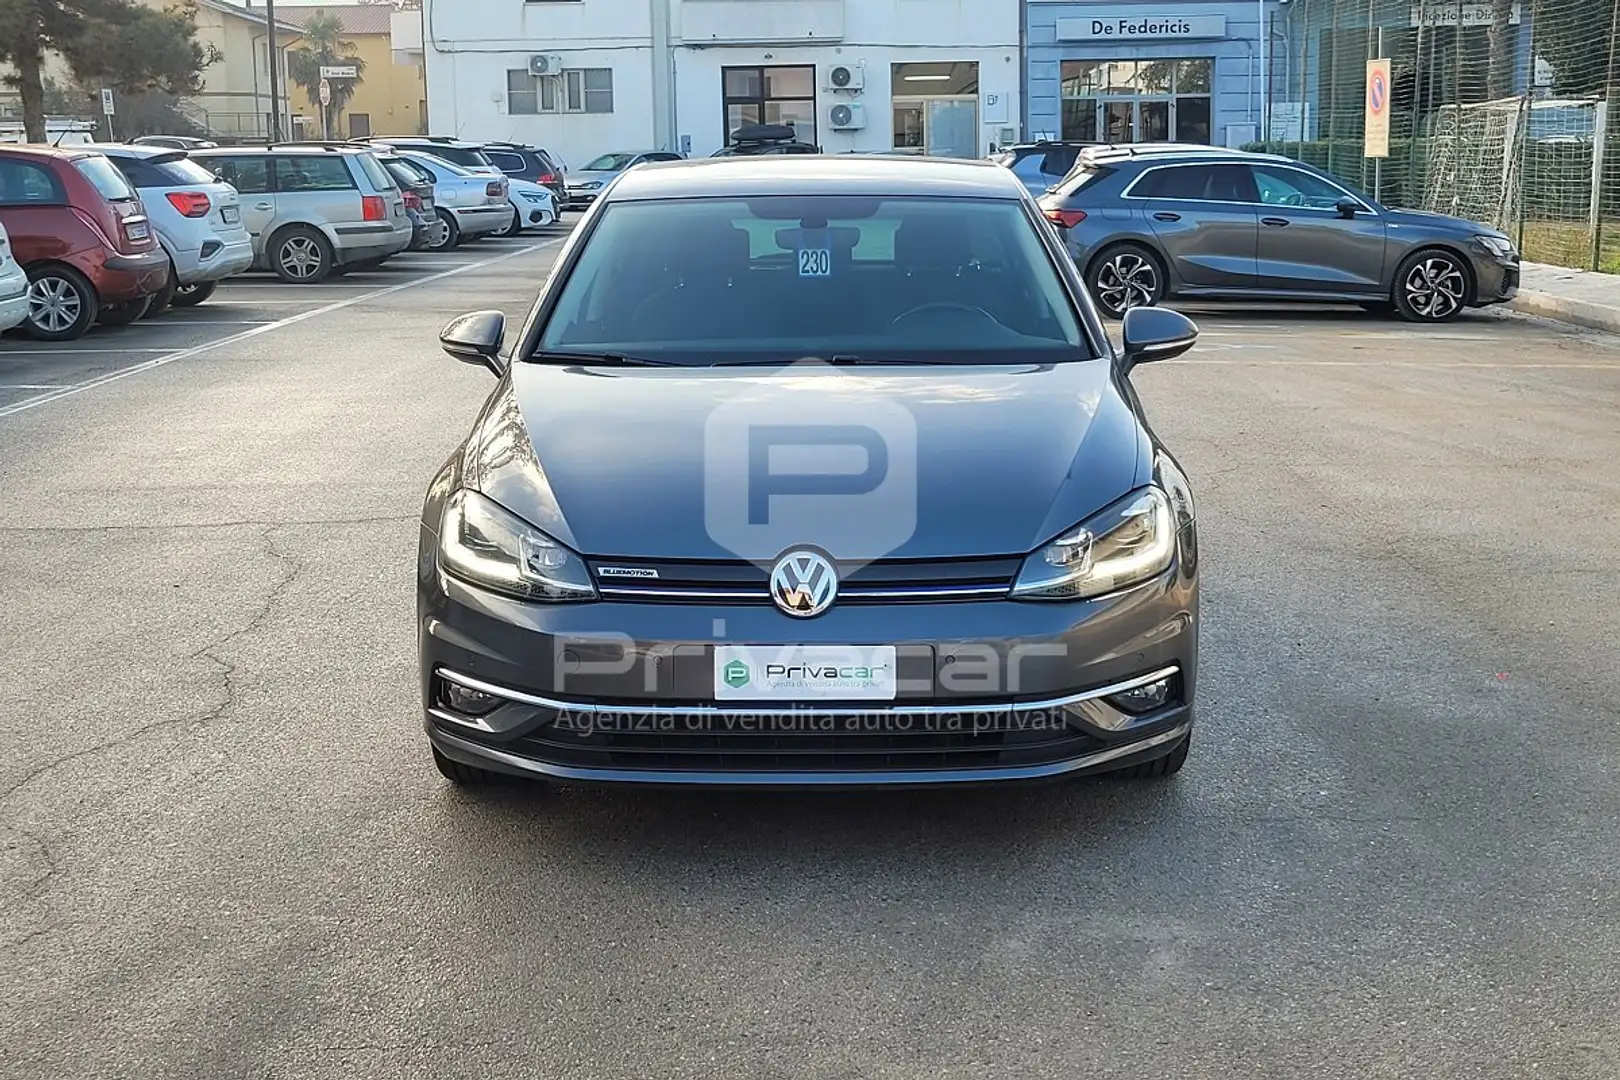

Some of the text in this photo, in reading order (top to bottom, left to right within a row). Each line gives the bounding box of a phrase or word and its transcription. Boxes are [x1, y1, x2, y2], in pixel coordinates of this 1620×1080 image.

[1092, 19, 1190, 35] De Federicis
[801, 250, 828, 273] 230
[603, 568, 655, 576] BLUEMOTION
[767, 662, 884, 679] Privacar
[766, 680, 795, 689] Agenzia
